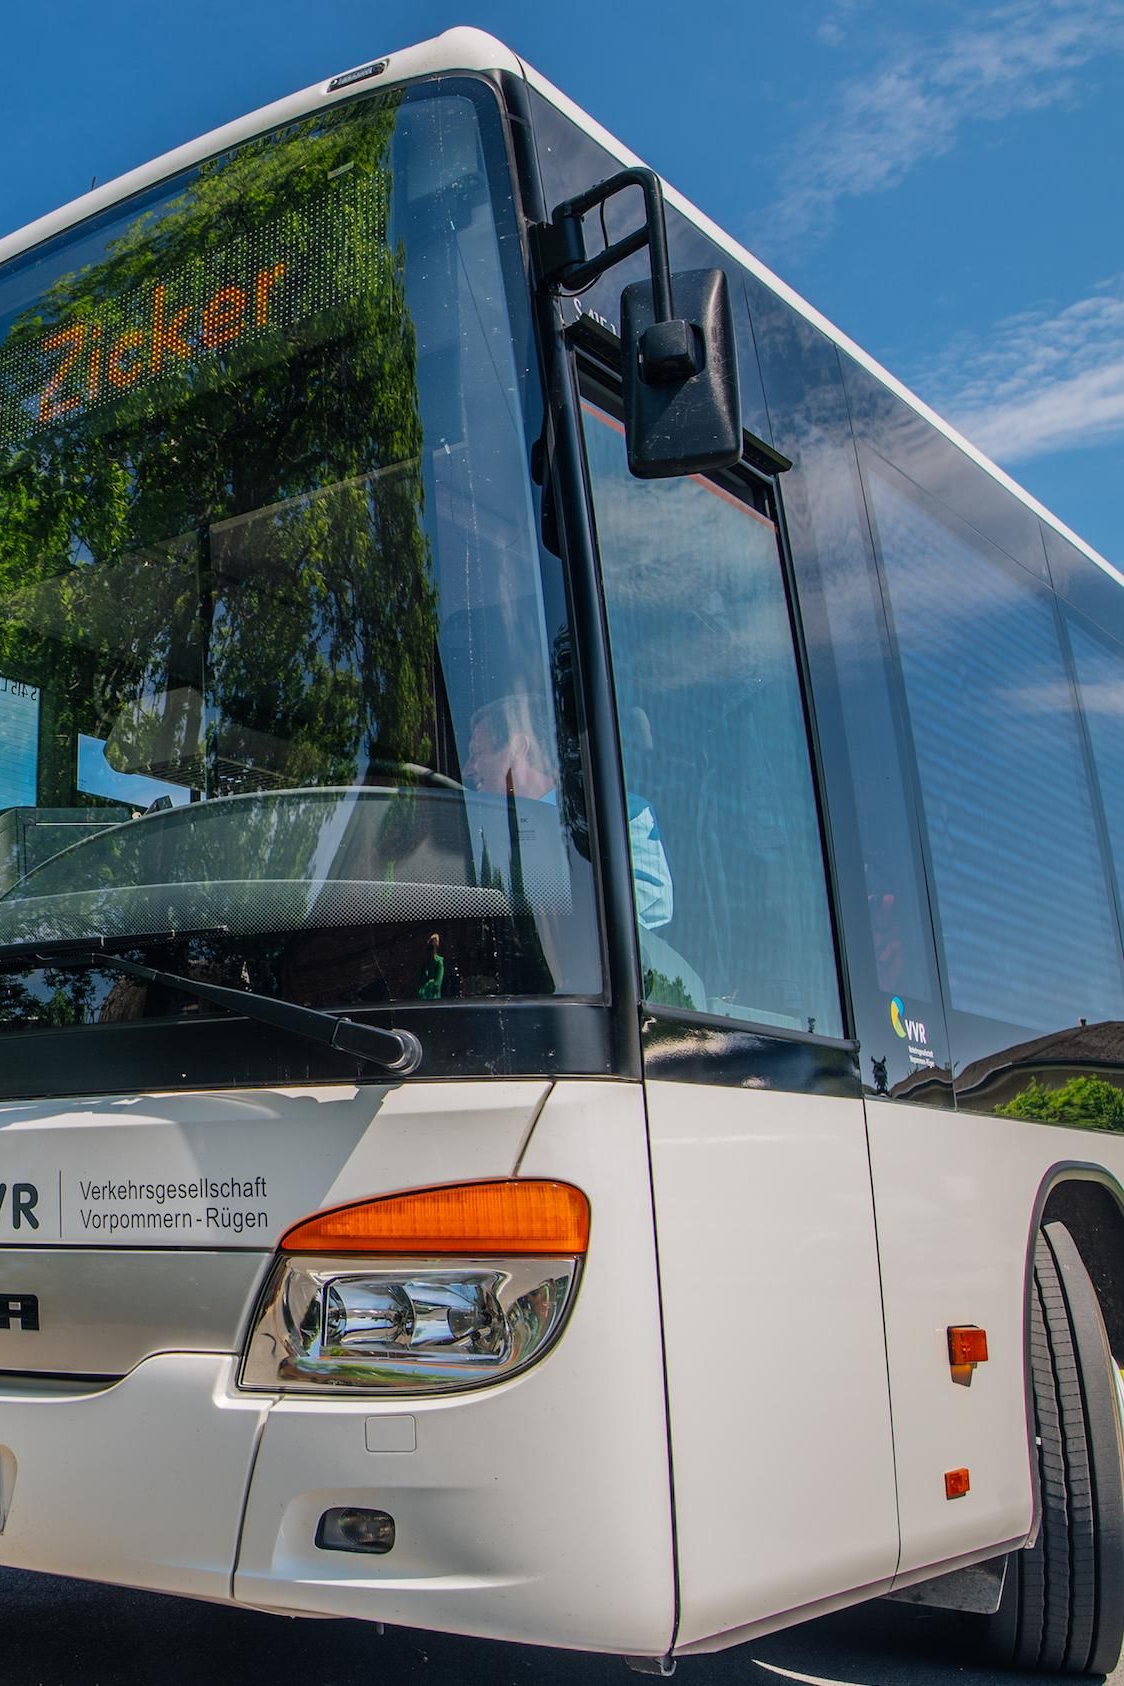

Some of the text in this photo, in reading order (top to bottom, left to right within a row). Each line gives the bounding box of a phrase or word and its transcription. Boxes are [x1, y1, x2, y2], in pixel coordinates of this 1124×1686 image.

[39, 263, 286, 423] Zicker
[905, 1019, 927, 1044] VVR
[79, 1176, 267, 1205] Verkehrsgesellschaft
